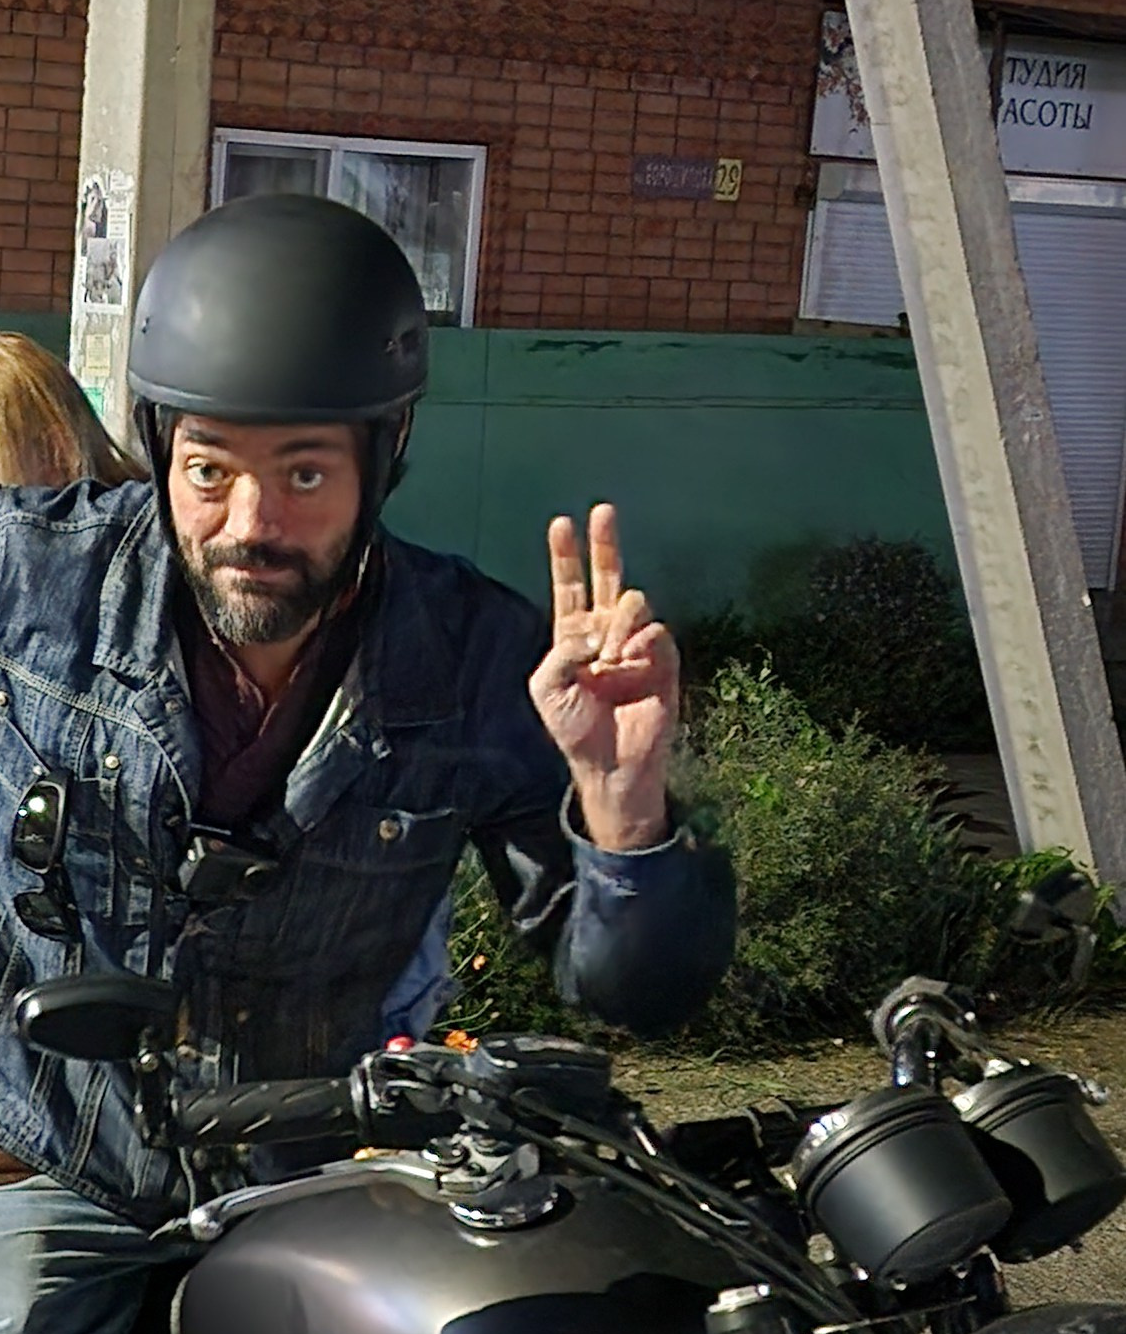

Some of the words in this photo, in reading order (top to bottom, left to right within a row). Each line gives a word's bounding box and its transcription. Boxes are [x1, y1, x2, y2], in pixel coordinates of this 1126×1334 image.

[1006, 57, 1087, 90] ТУДИЯ
[998, 97, 1093, 130] АСОТЫ
[715, 164, 740, 196] 29
